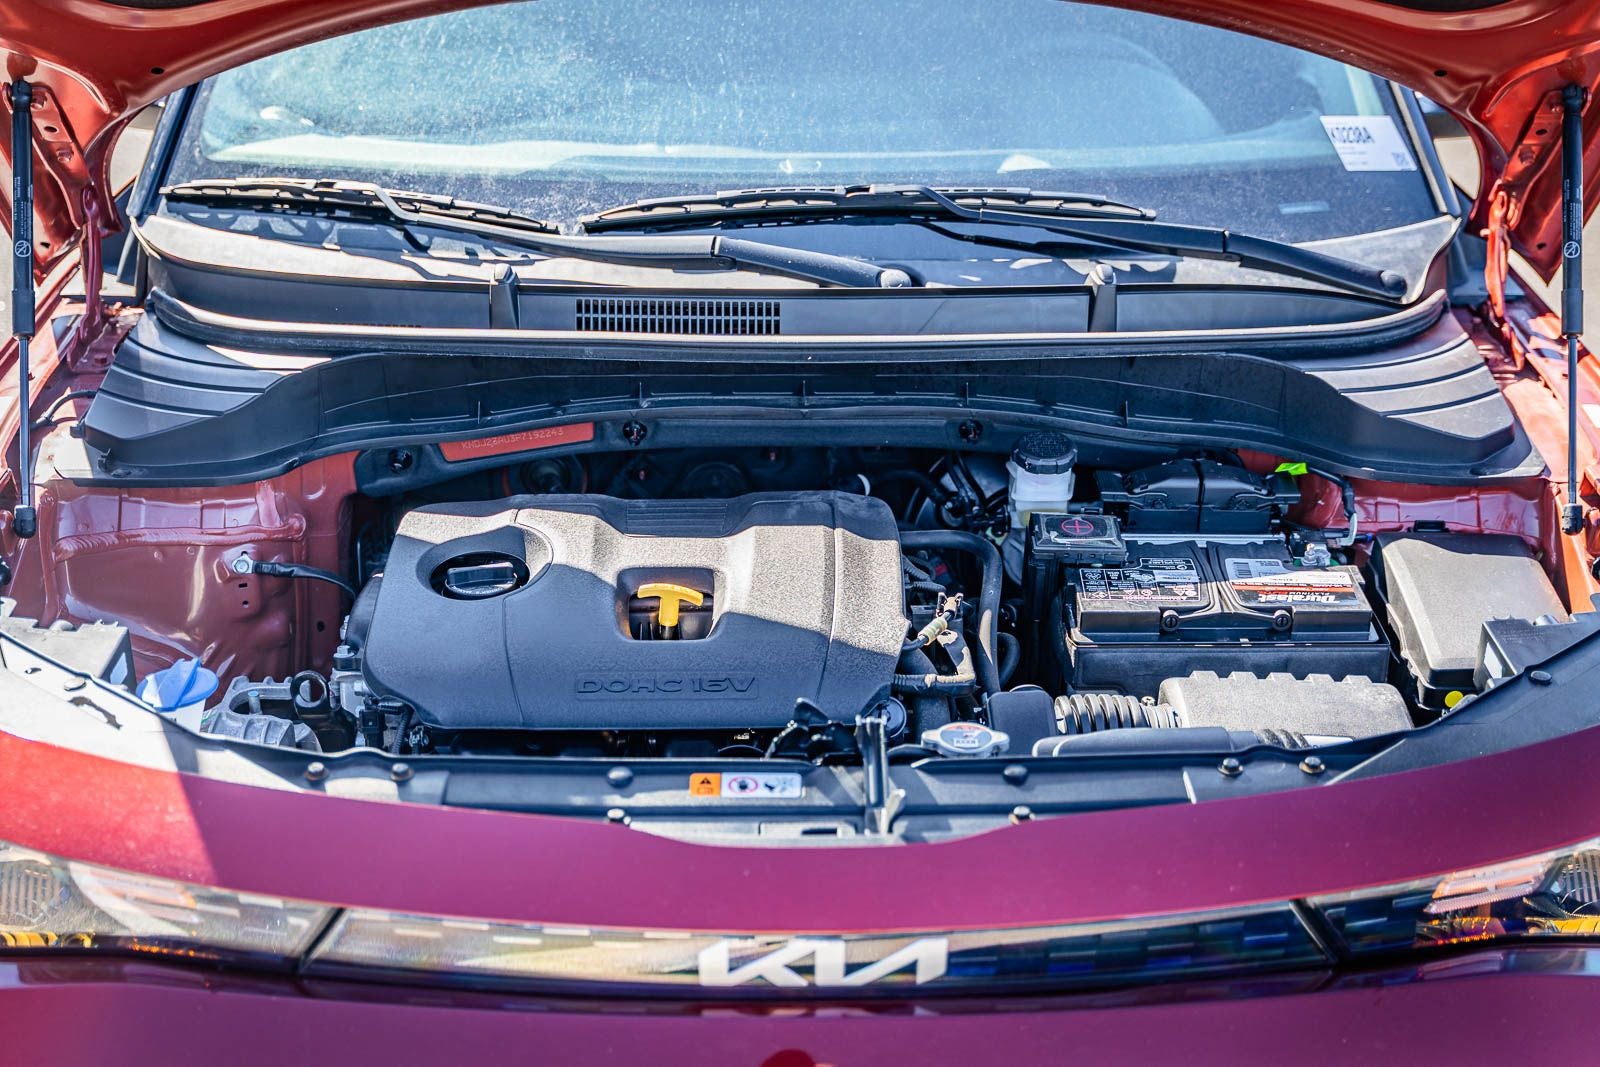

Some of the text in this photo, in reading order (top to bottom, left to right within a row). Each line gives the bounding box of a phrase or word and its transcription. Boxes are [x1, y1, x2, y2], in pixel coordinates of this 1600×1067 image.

[1258, 593, 1336, 603] Duralast
[576, 677, 756, 693] DOHC 16V
[698, 937, 949, 986] KIA
